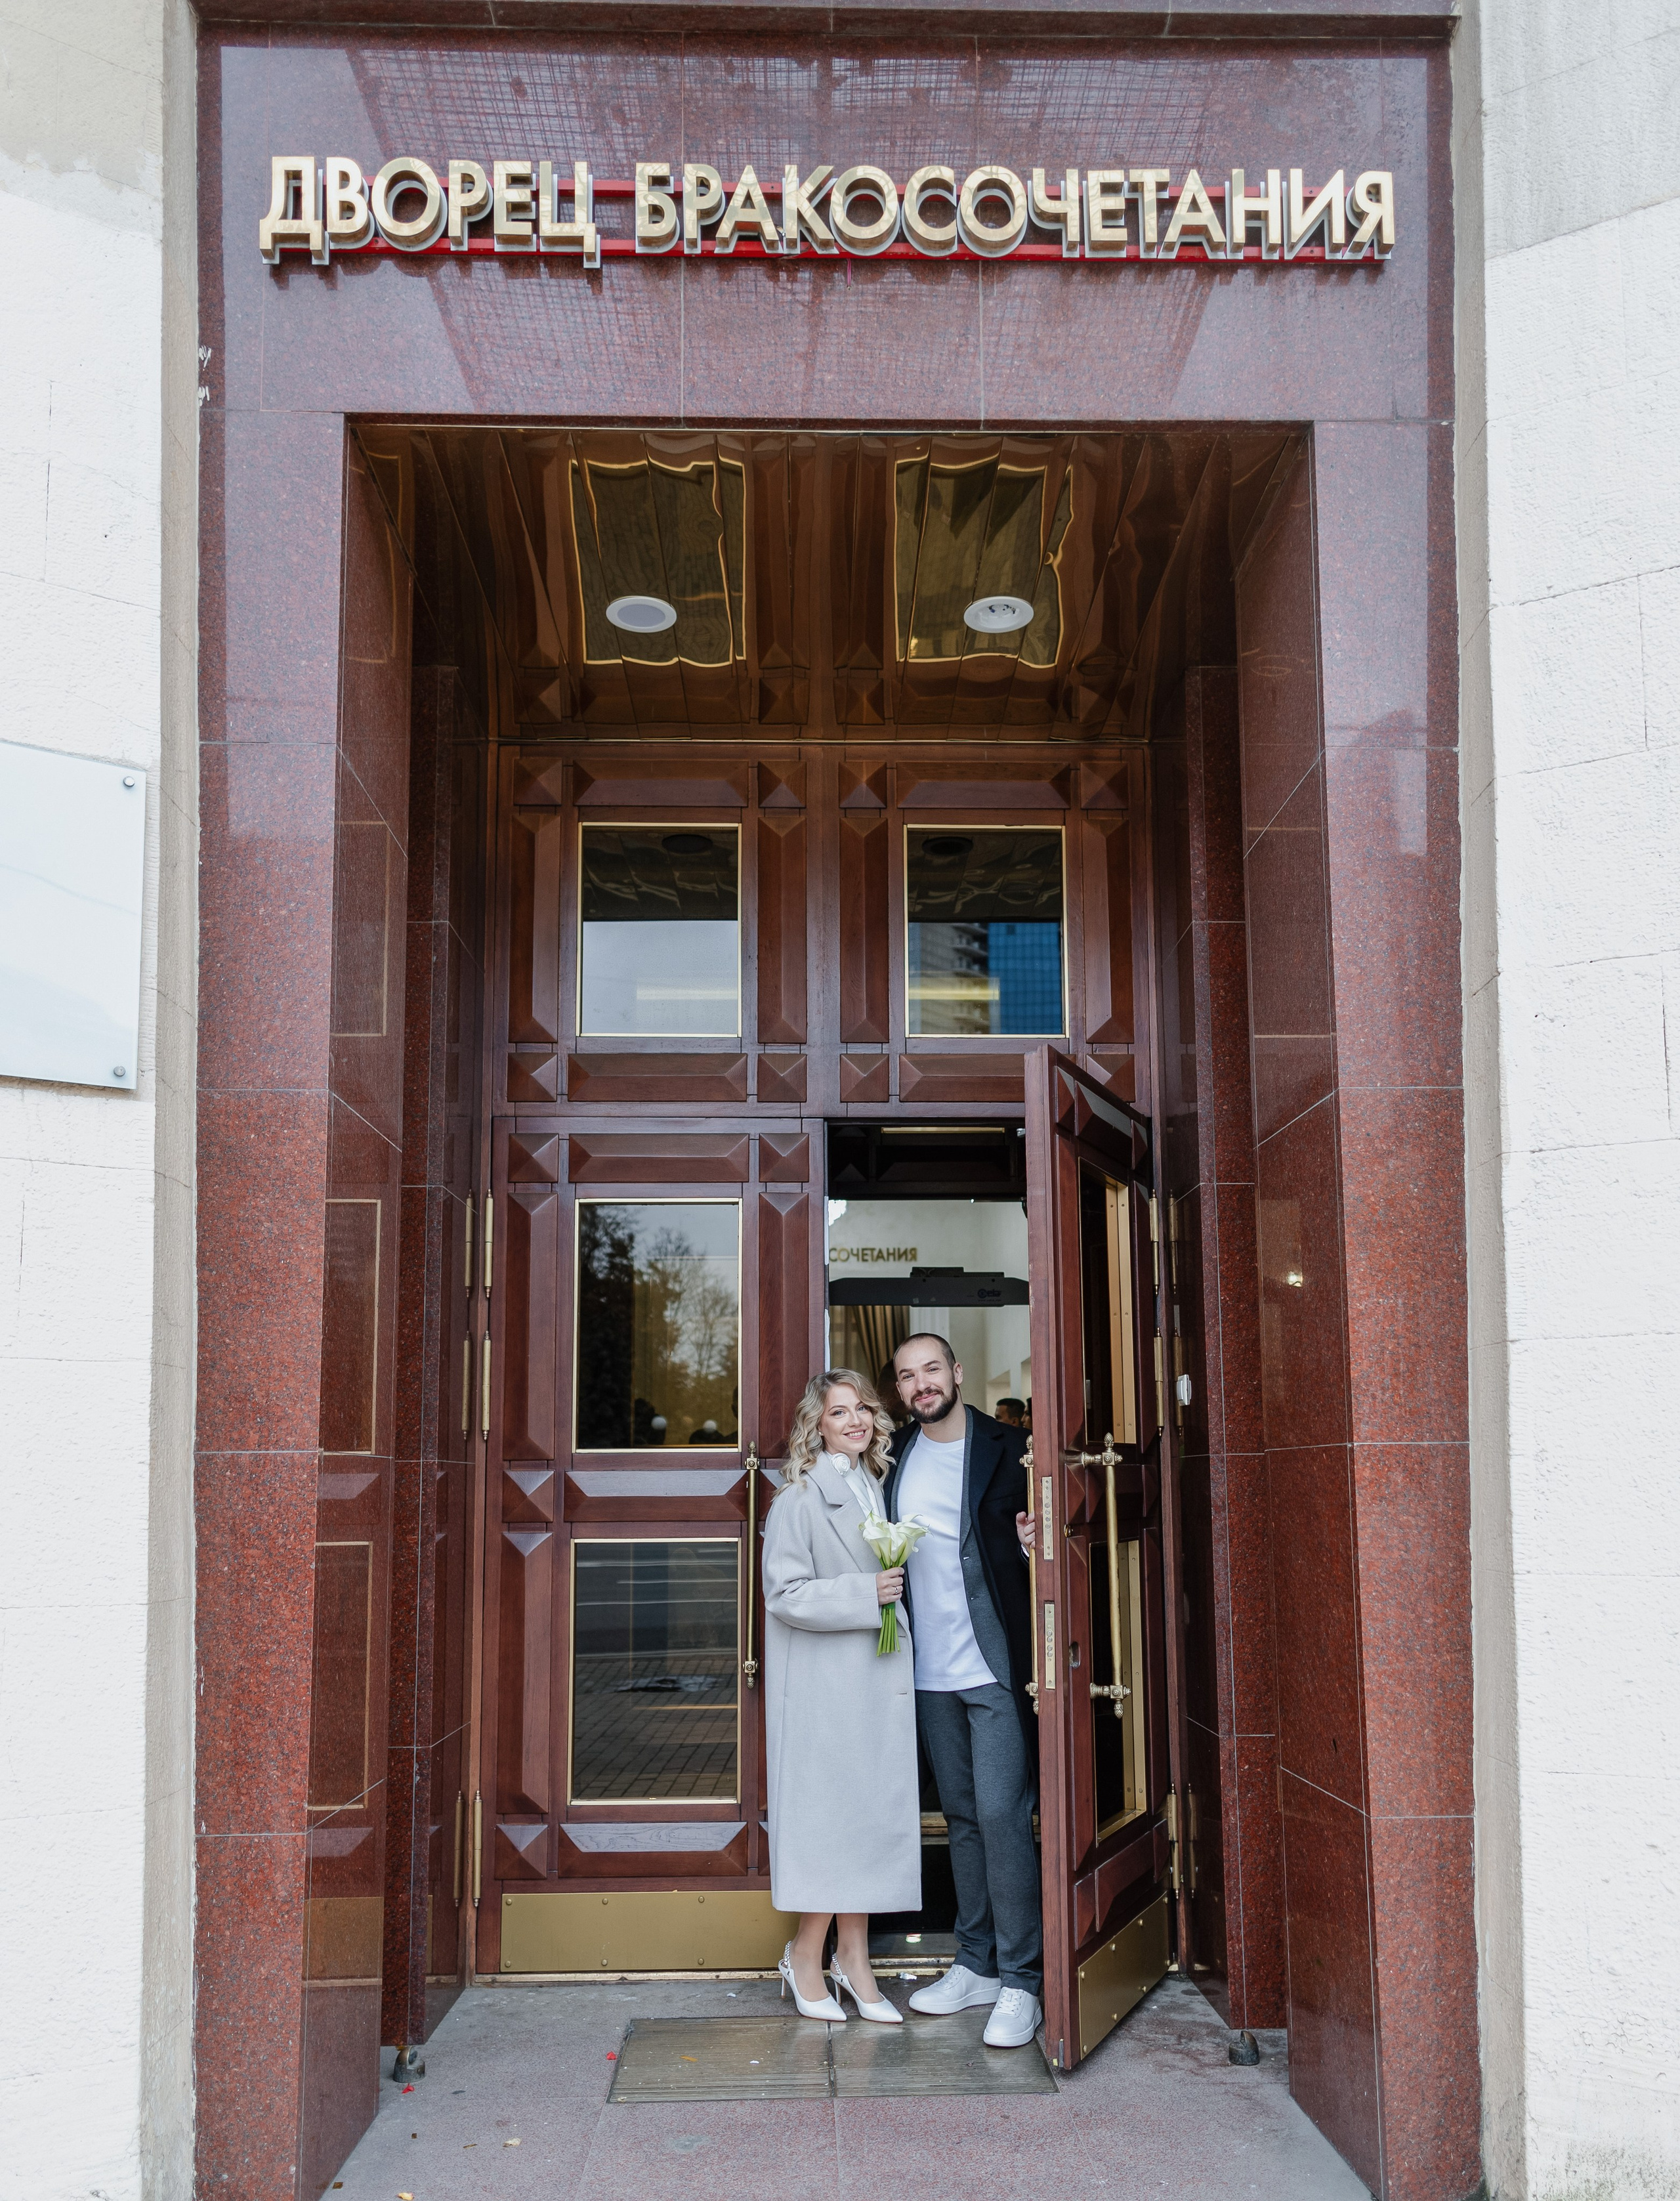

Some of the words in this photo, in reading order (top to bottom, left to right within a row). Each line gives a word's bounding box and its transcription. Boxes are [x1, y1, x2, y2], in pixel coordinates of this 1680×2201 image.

[259, 156, 600, 268] ДВОРЕЦ
[635, 161, 1395, 260] БРАКОСОЧЕТАНИЯ
[829, 1247, 917, 1262] СОЧЕТАНИЯ
